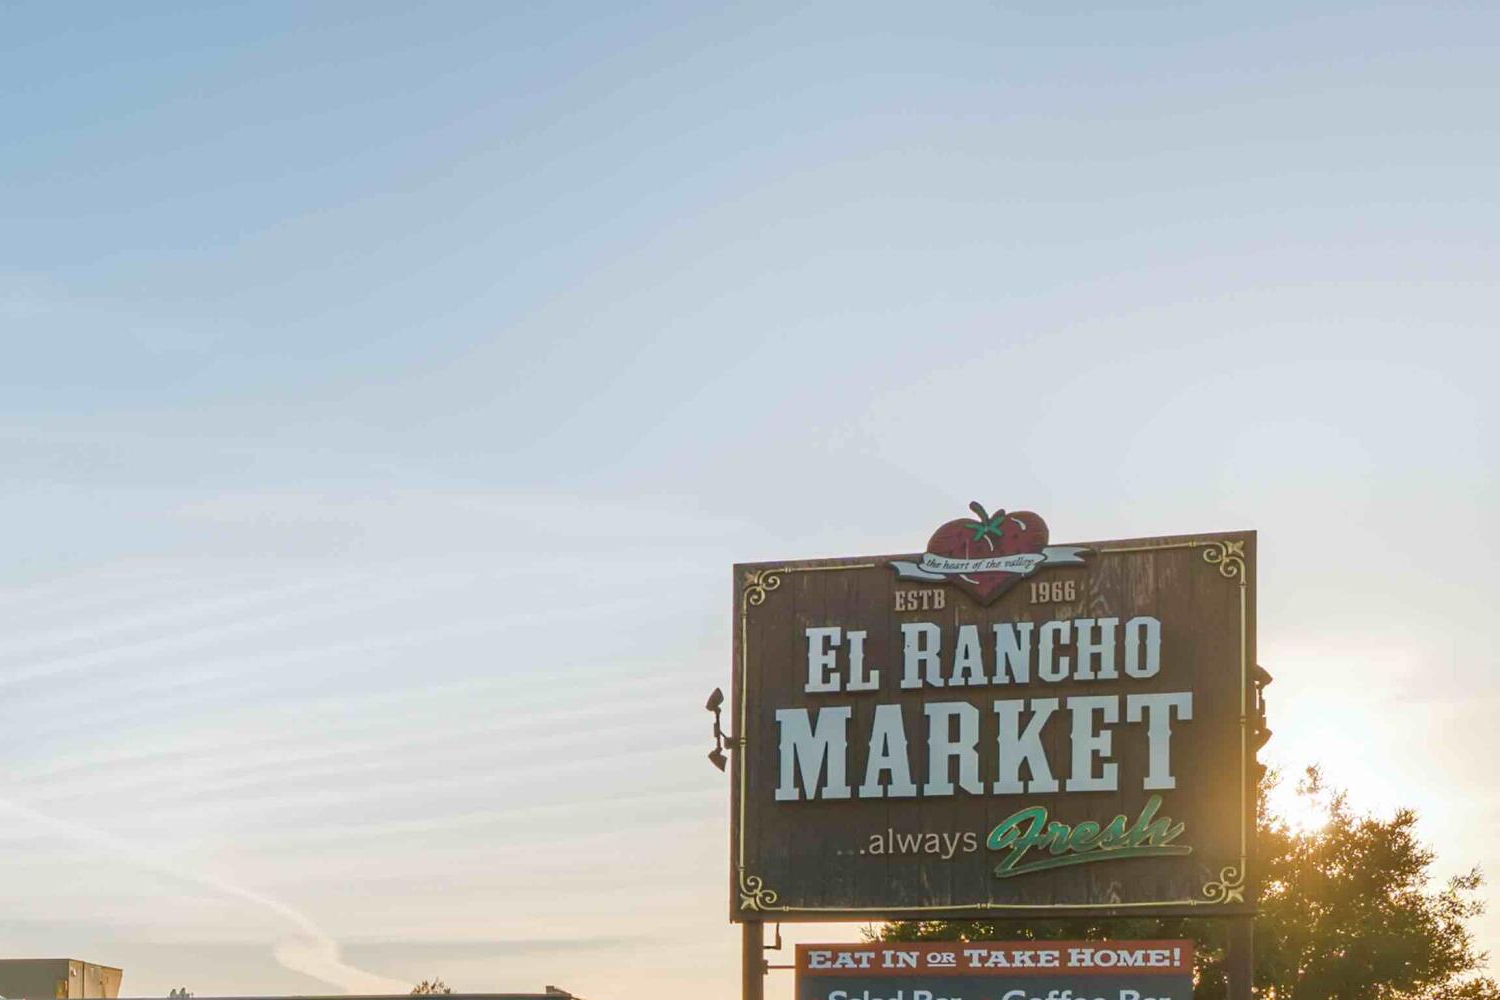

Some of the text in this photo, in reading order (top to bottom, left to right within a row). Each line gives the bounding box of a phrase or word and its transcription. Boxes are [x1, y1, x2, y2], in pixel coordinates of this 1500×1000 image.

[926, 559, 941, 569] the
[943, 560, 969, 570] heart
[973, 559, 984, 570] of
[986, 559, 1000, 569] the
[895, 581, 1076, 612] ESTB 1966
[804, 615, 1162, 693] EL RANCHO
[774, 691, 1193, 802] MARKET
[986, 795, 1193, 878] Fresh
[807, 947, 1182, 969] EAT IN OR TAKE HOME!
